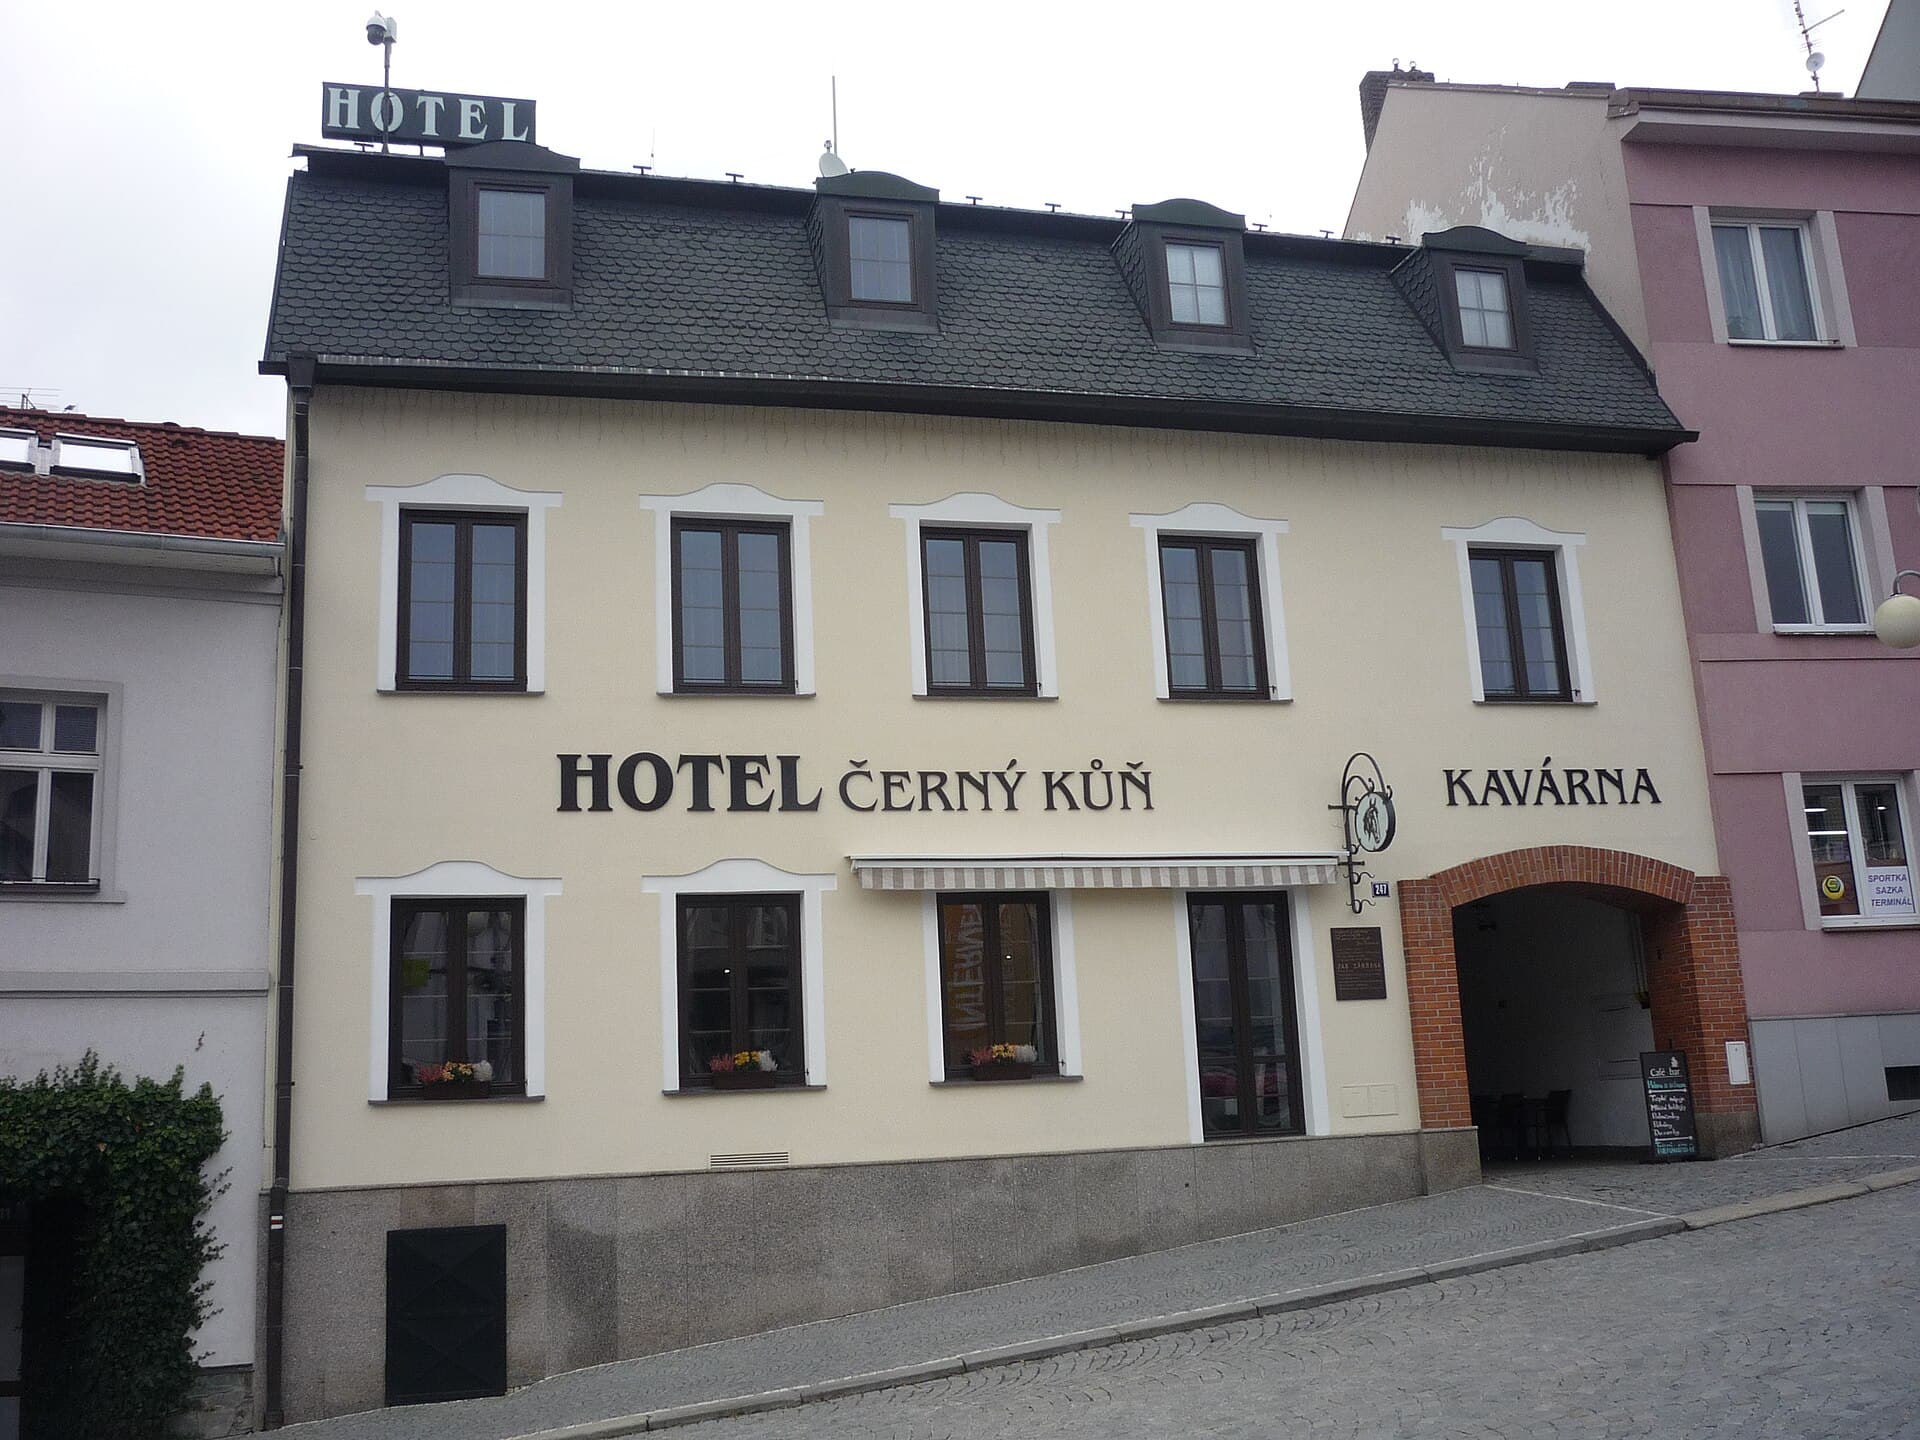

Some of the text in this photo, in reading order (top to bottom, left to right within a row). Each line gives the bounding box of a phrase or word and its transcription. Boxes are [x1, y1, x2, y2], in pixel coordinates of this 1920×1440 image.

[327, 87, 529, 141] HOTEL
[556, 751, 1155, 812] HOTEL ČERNÝ KŮŇ
[1442, 756, 1663, 806] KAVÁRNA
[1375, 884, 1387, 895] 247
[1867, 873, 1908, 883] SPORTKA
[1875, 886, 1904, 895] SAZKA
